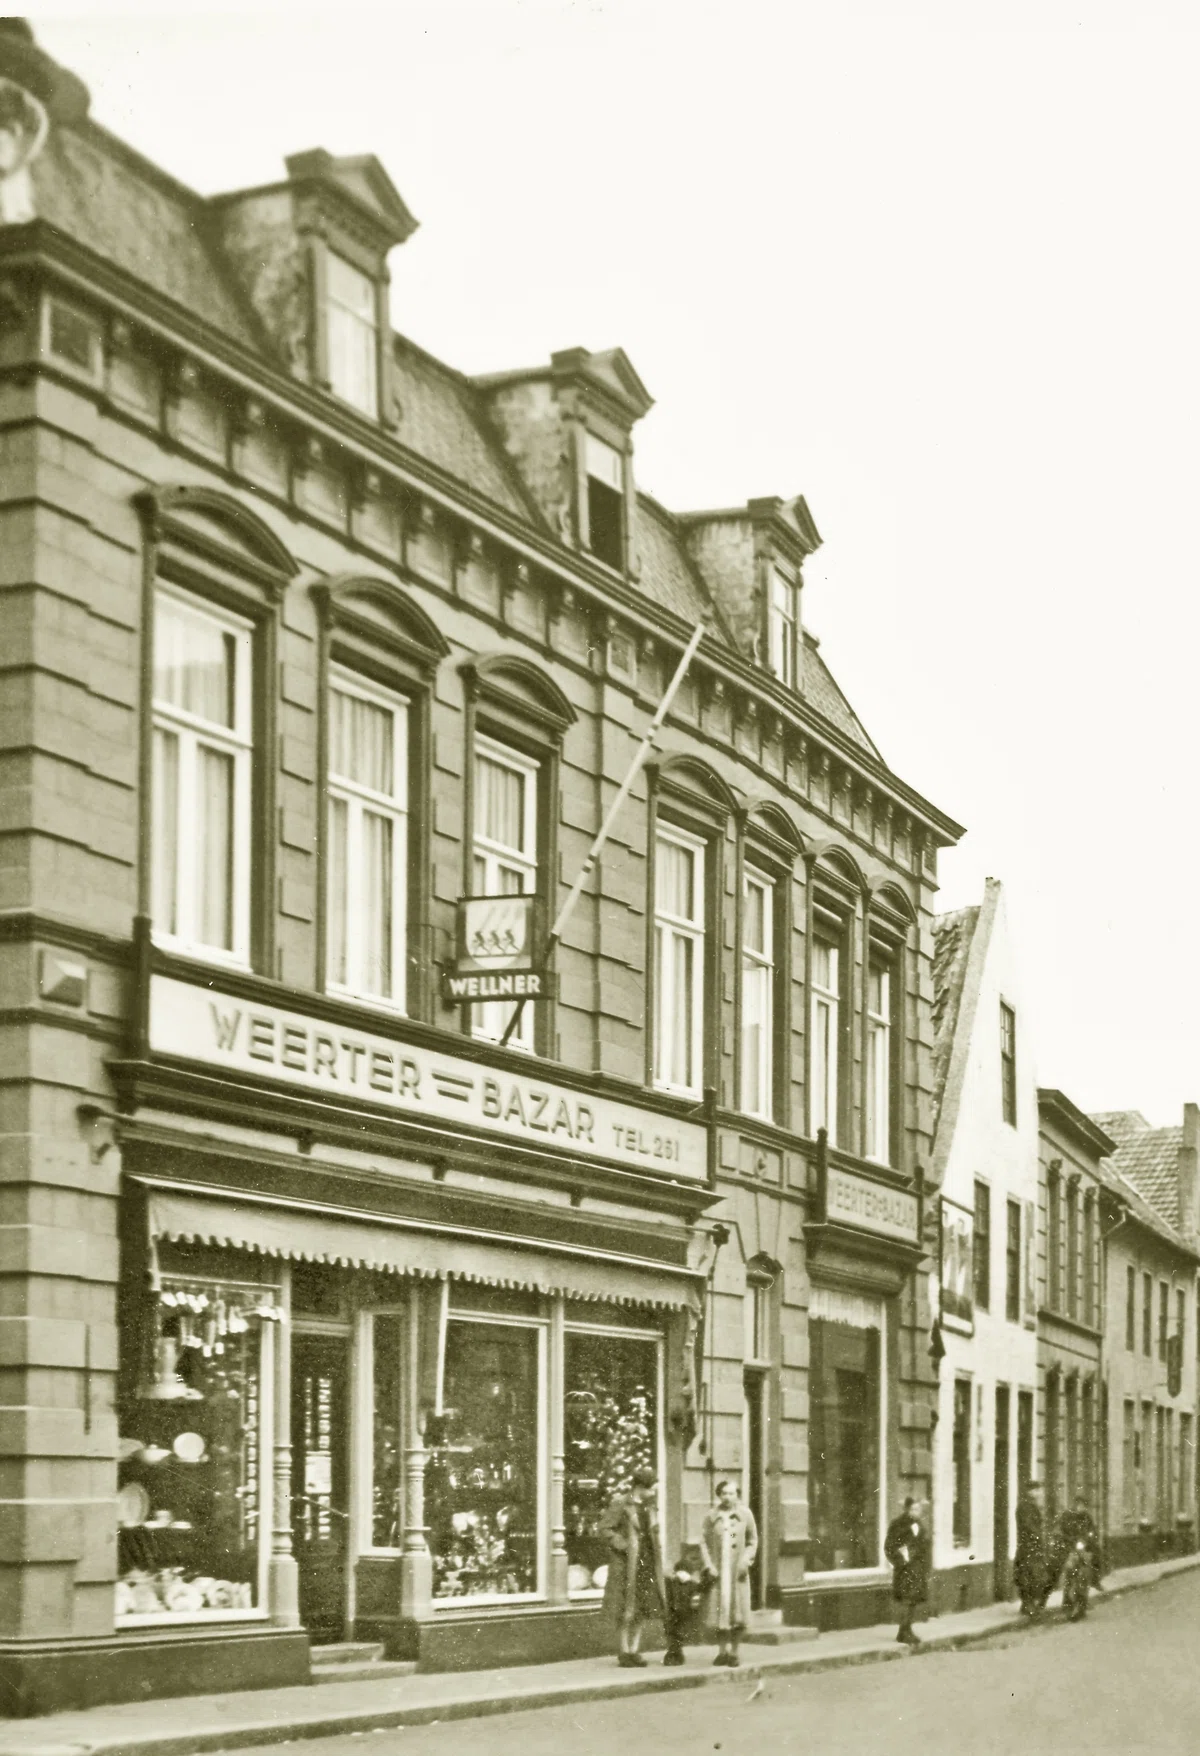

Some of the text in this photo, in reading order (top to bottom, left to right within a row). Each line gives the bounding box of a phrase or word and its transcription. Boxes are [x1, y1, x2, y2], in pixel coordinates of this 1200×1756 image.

[449, 974, 541, 996] WELLNER
[209, 1002, 422, 1100] WEERTER
[481, 1077, 595, 1144] BAZAR
